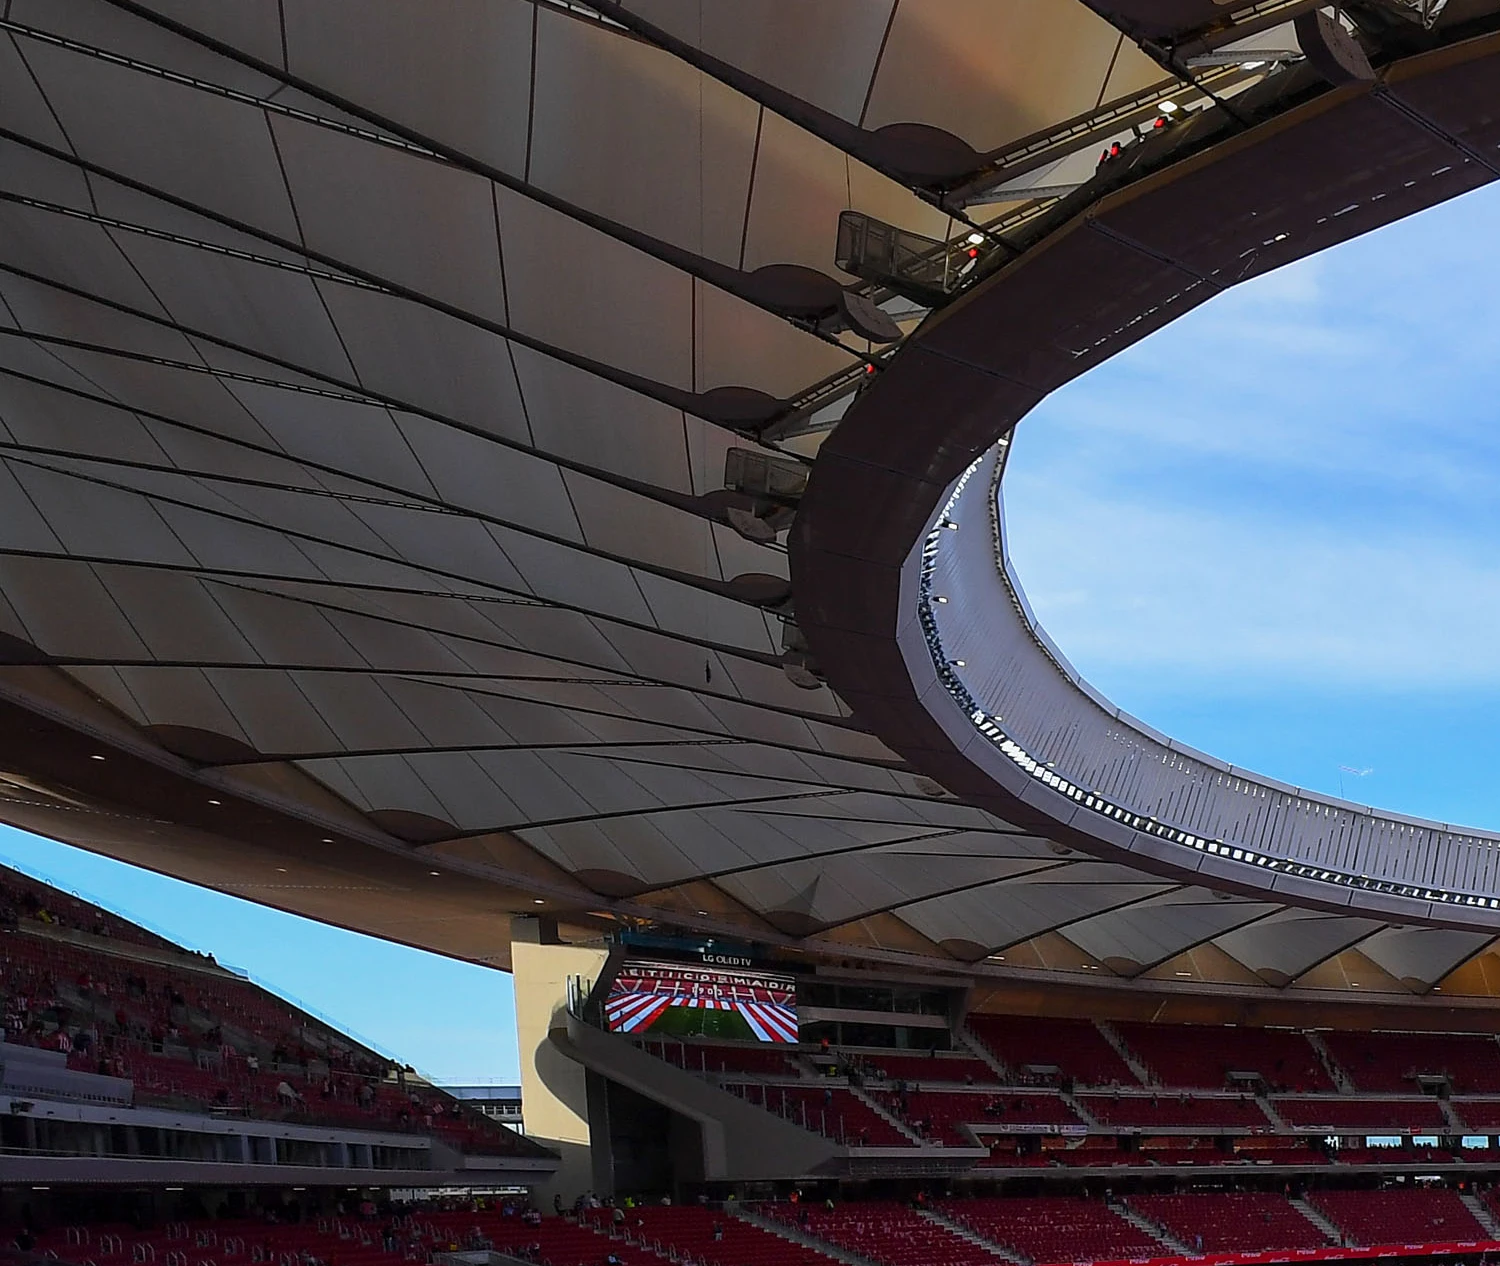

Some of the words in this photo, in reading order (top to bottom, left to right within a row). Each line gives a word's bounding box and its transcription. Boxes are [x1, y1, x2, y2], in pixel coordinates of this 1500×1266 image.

[702, 954, 715, 963] LG
[716, 955, 740, 965] OLED
[740, 957, 752, 967] TV
